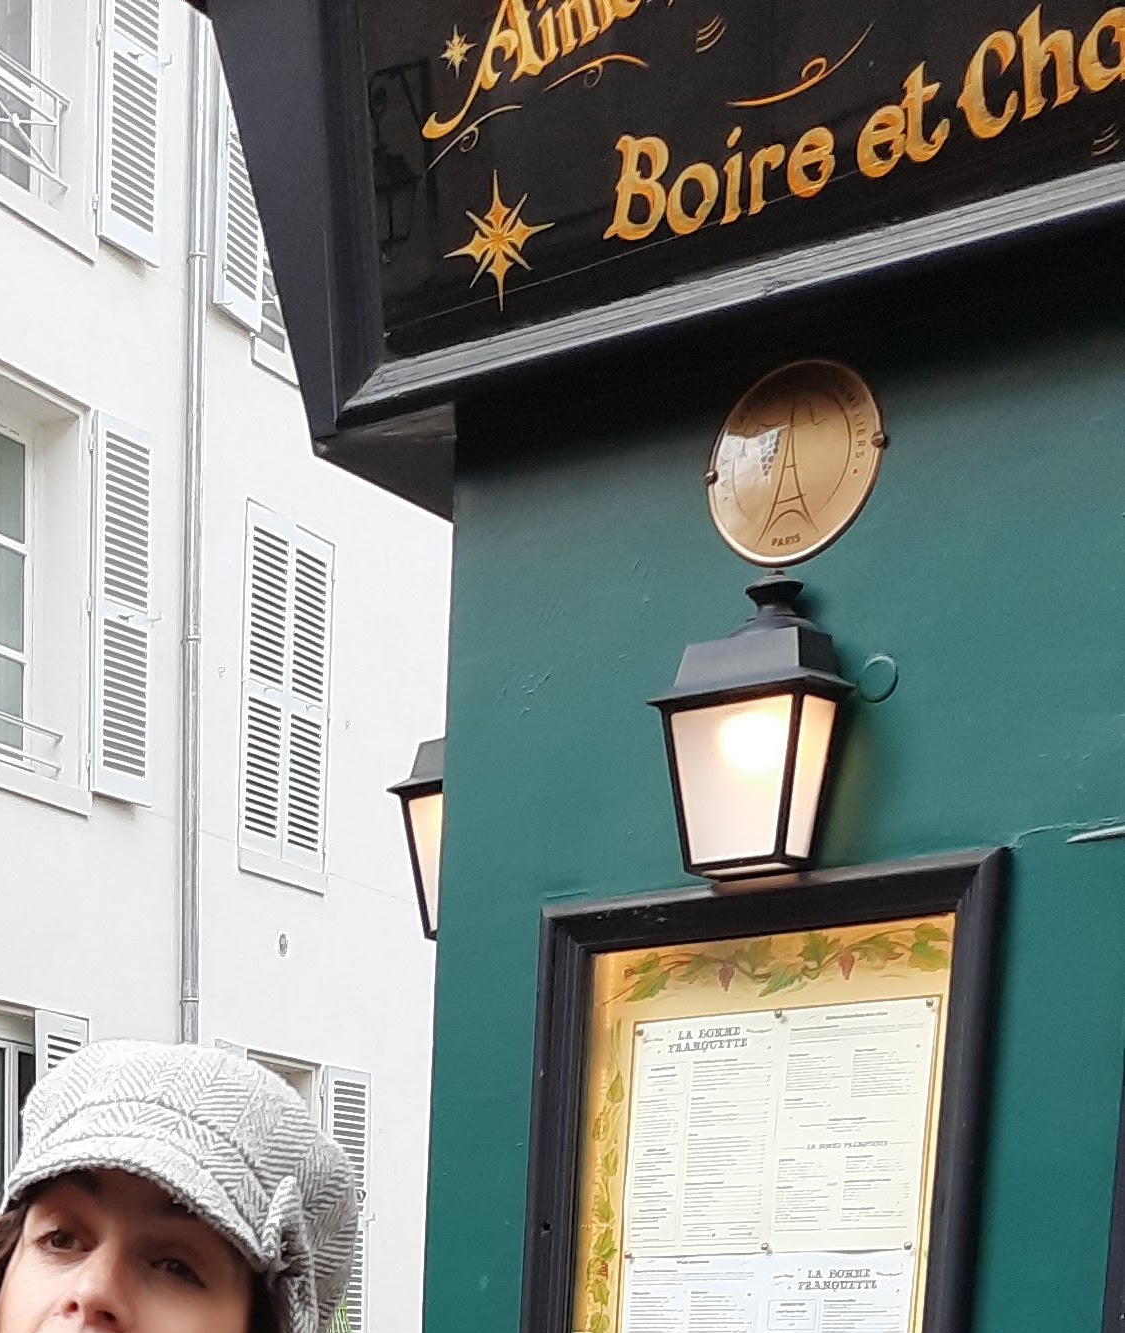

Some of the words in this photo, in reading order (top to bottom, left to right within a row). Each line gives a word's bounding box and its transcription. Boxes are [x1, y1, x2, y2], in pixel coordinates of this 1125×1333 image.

[603, 126, 836, 241] Boire
[856, 60, 950, 178] et
[771, 533, 801, 547] PARIS
